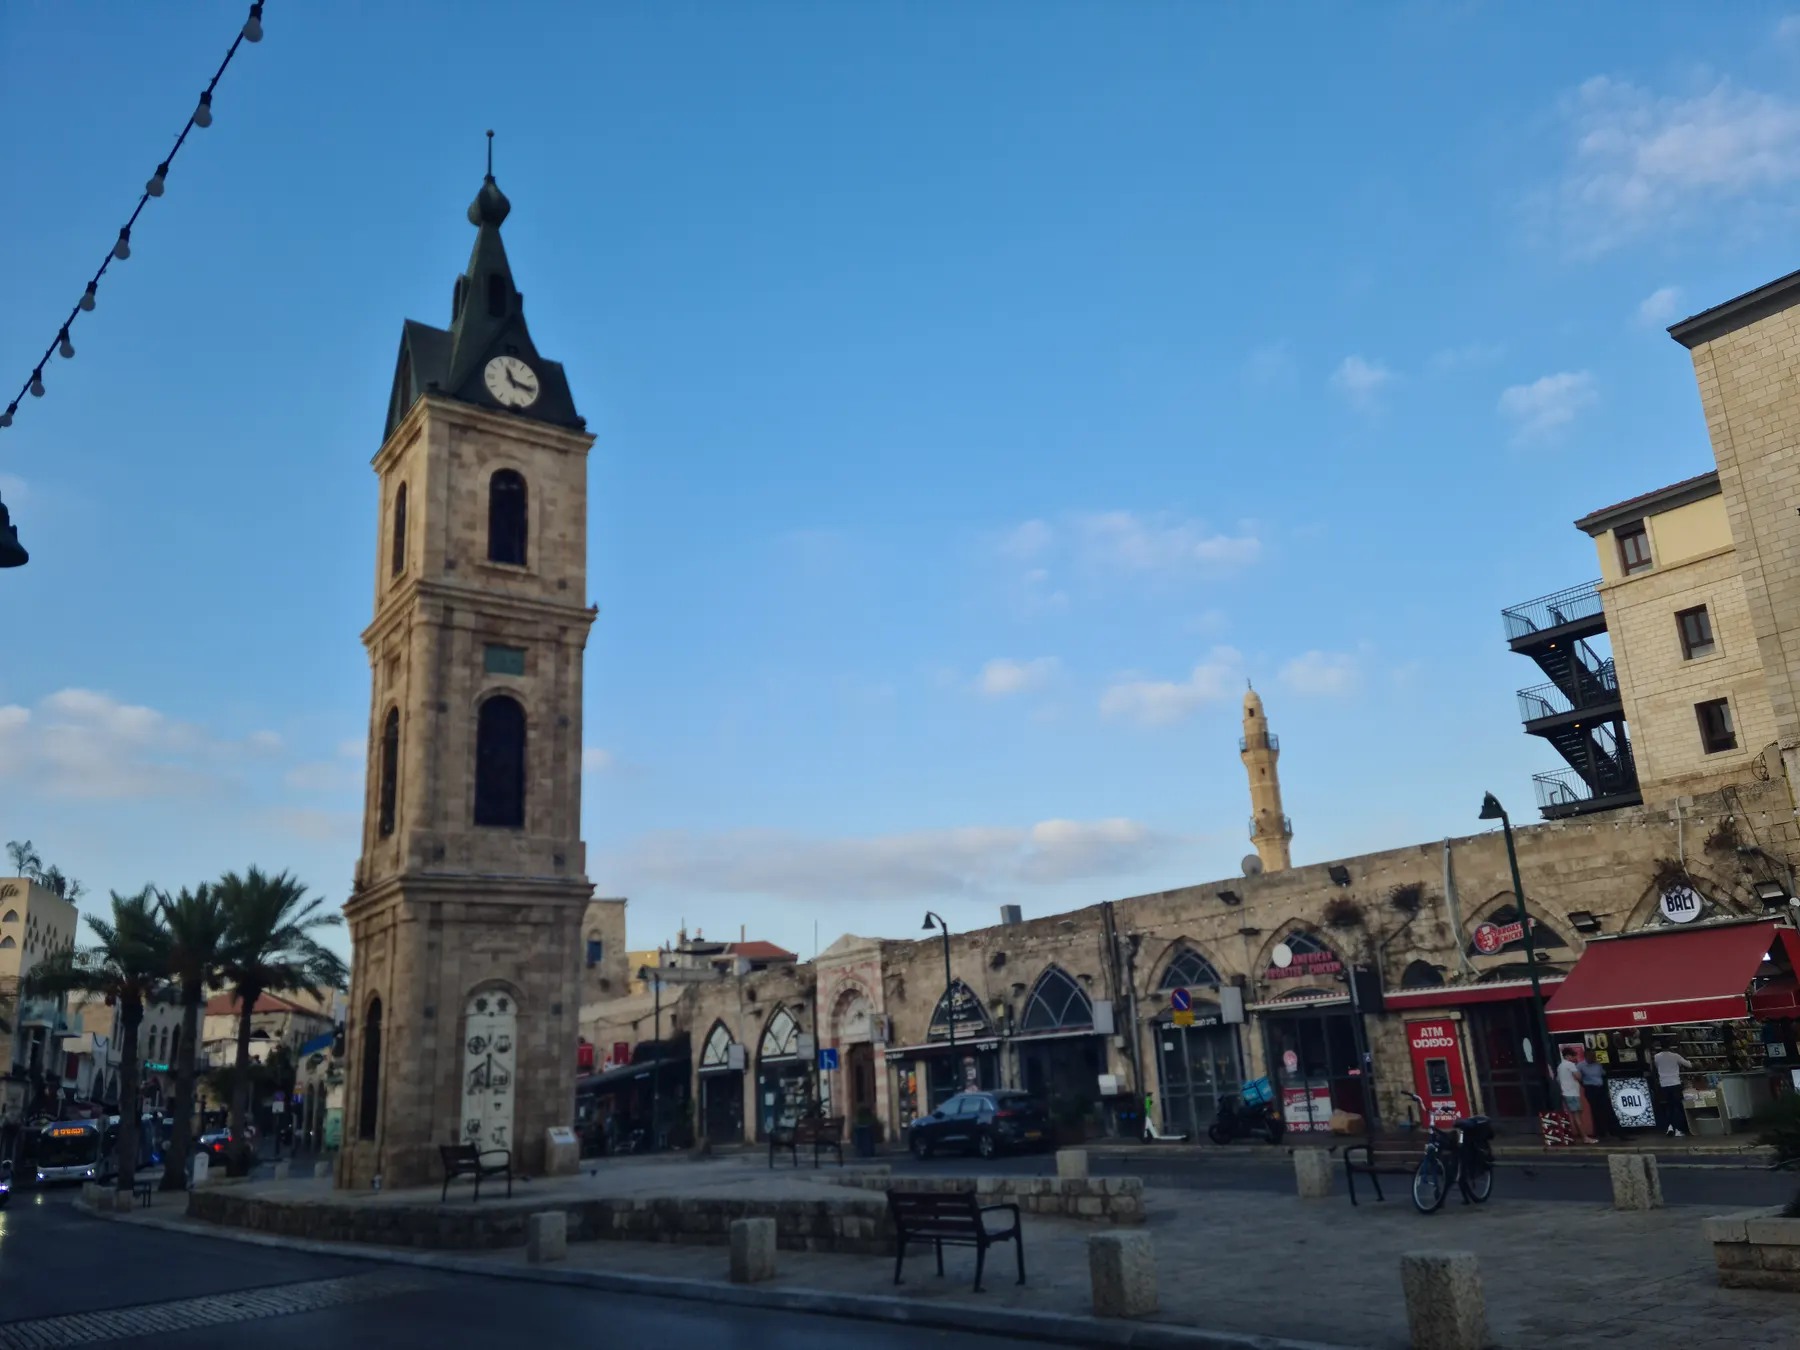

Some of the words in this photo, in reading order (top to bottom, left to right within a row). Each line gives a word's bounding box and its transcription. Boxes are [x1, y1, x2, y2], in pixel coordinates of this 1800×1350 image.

[1666, 892, 1694, 912] BALI
[1632, 1011, 1647, 1020] BALI
[1420, 1026, 1443, 1037] ATM
[1412, 1037, 1454, 1048] כספומט
[1621, 1095, 1642, 1107] BALI
